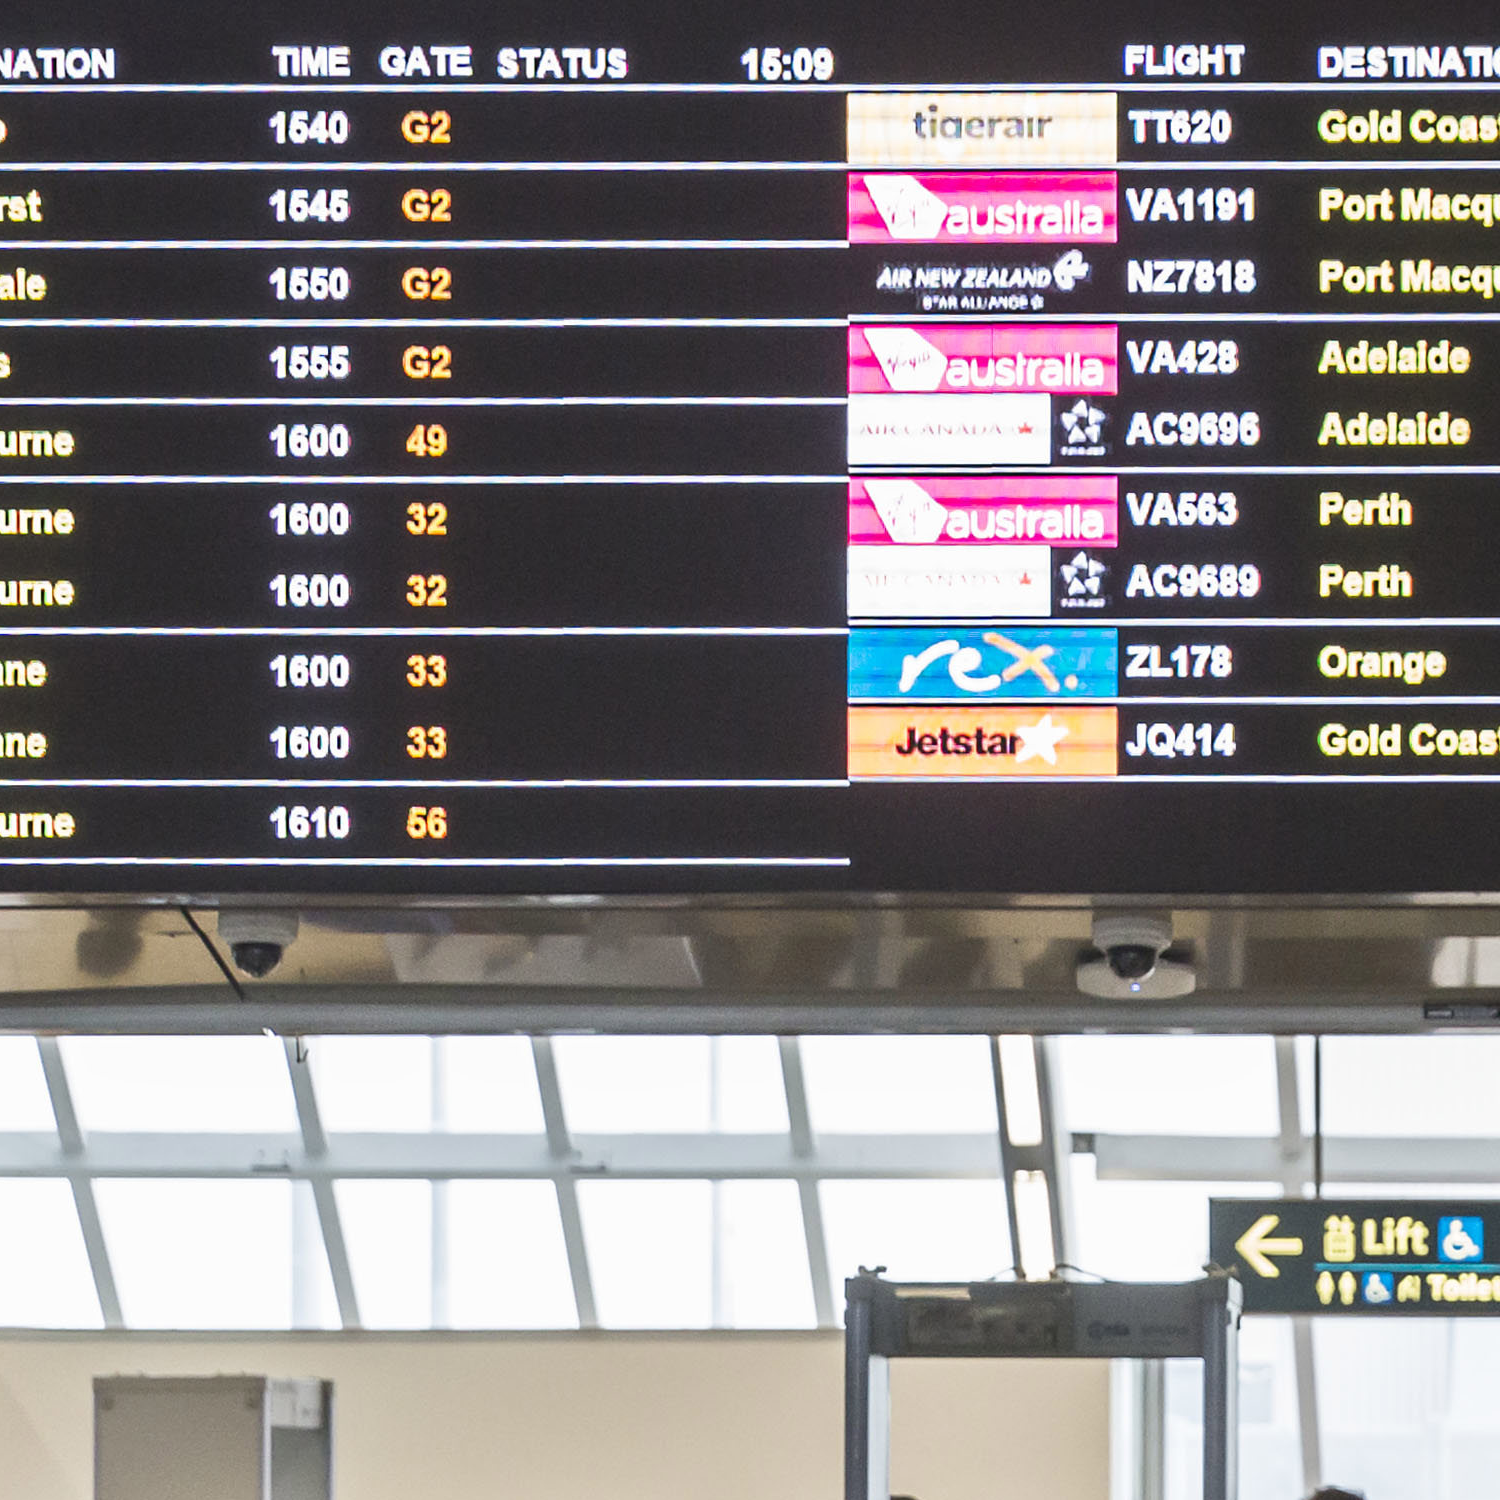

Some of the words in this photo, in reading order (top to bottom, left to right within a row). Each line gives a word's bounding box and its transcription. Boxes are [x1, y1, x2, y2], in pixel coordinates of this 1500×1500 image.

[271, 45, 350, 77] TIME
[379, 46, 473, 77] GATE
[497, 47, 628, 79] STATUS
[740, 47, 834, 80] 15:09
[269, 111, 350, 144] 1540
[401, 111, 451, 143] G2
[269, 189, 351, 222] 1545
[402, 189, 451, 222] G2
[1126, 188, 1254, 221] VA1191
[1319, 188, 1395, 221] Port
[268, 267, 351, 300] 1550
[402, 267, 451, 300] G2
[269, 346, 351, 379] 1555
[403, 346, 451, 378] G2
[1126, 340, 1239, 374] VA428
[1318, 340, 1471, 374] Adelaide
[269, 424, 351, 457] 1600
[406, 424, 447, 456] 49
[269, 503, 351, 535] 1600
[407, 503, 447, 535] 32
[1126, 492, 1239, 526] VA563
[1320, 492, 1412, 525] Perth
[269, 574, 349, 607] 1600
[406, 575, 447, 606] 32
[269, 655, 349, 687] 1600
[407, 655, 447, 687] 33
[270, 726, 349, 758] 1600
[407, 726, 446, 758] 33
[896, 727, 1020, 754] Jetstar
[1126, 723, 1236, 758] JQ414
[1317, 723, 1401, 756] Gold
[270, 806, 350, 838] 1610
[406, 807, 447, 839] 56
[1363, 1217, 1428, 1255] Lift
